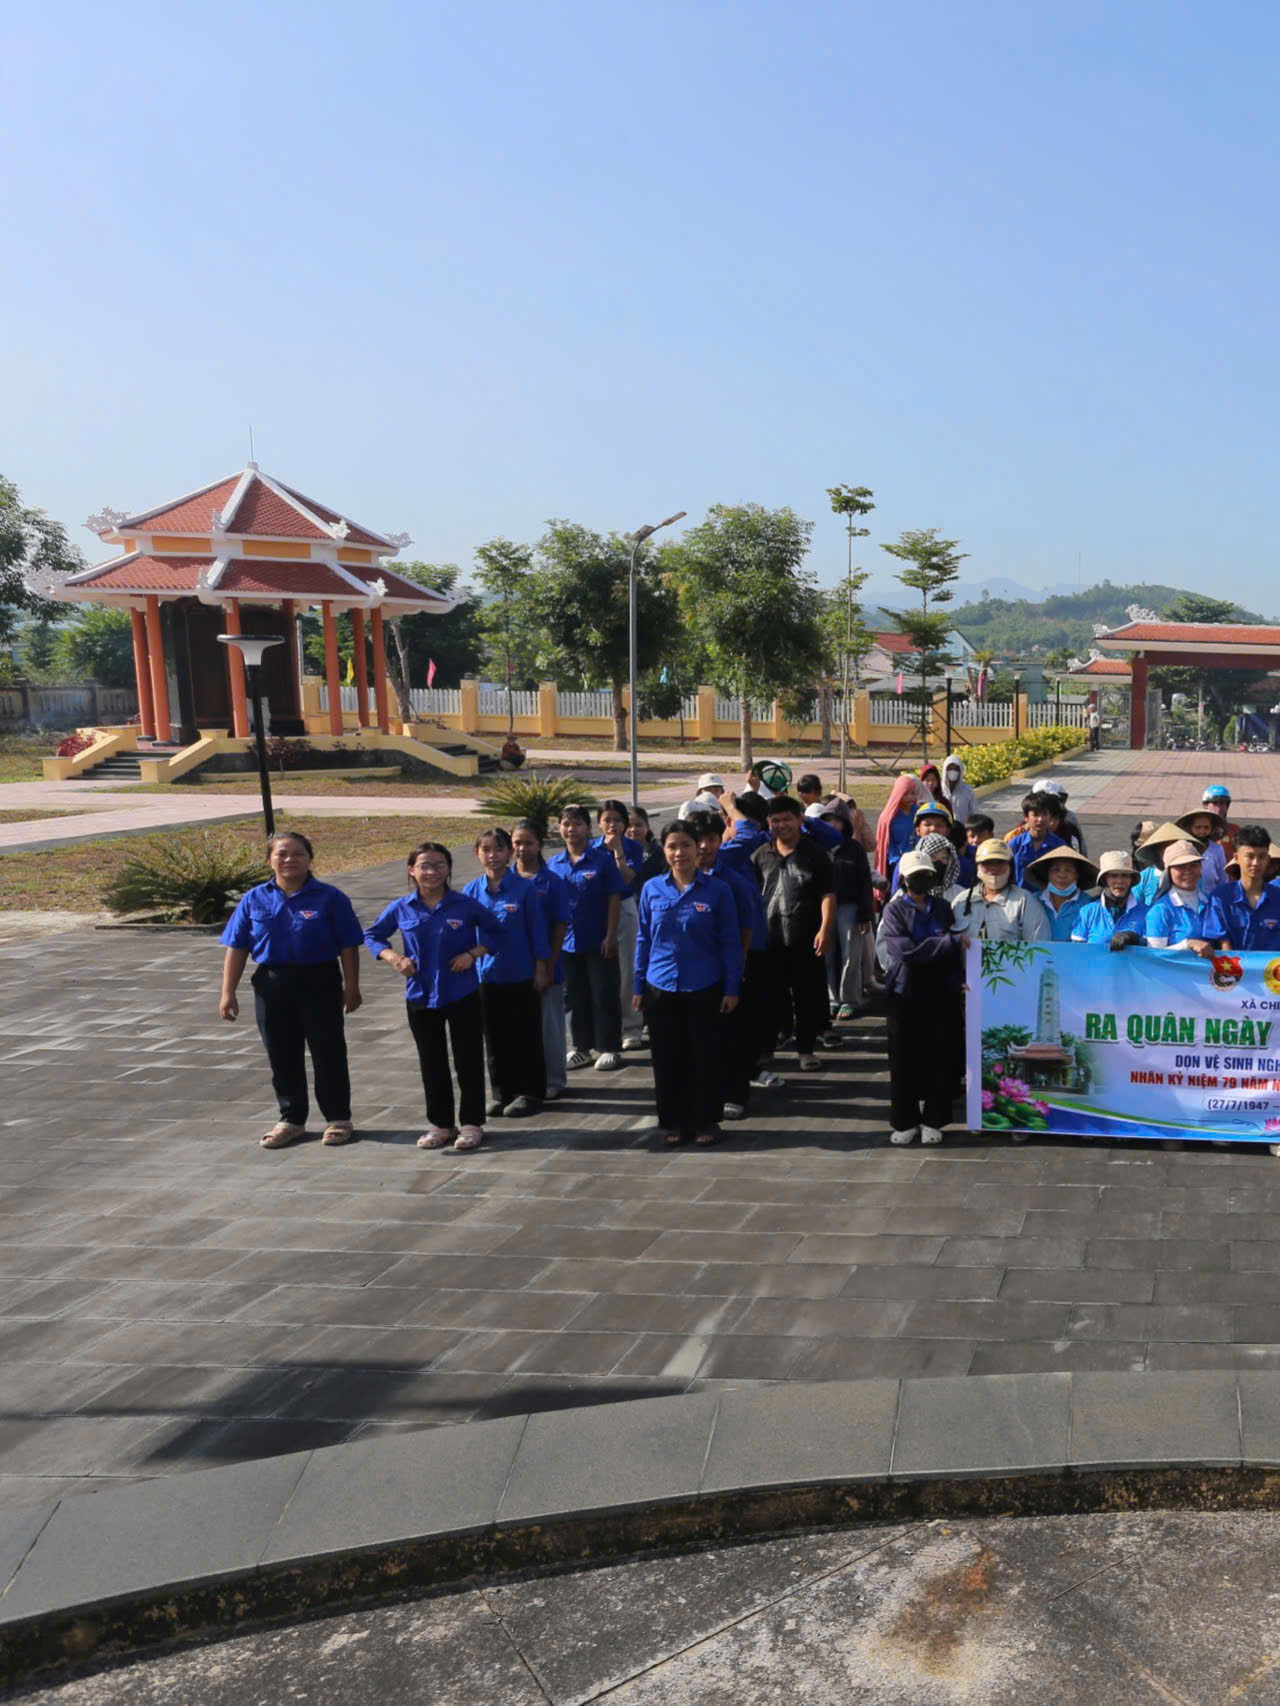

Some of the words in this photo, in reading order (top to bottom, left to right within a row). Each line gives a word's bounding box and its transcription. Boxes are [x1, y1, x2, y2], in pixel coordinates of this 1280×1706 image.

[1086, 1013, 1117, 1040] RA
[1127, 1012, 1194, 1045] QUÂN
[1205, 1016, 1271, 1047] NGÀY
[1175, 1054, 1200, 1071] DỌN
[1204, 1054, 1219, 1072] VỆ
[1224, 1057, 1253, 1070] SINH
[1188, 1073, 1217, 1089] NIỆM
[1222, 1076, 1237, 1088] 79
[1208, 1098, 1269, 1111] (27/7/1947
